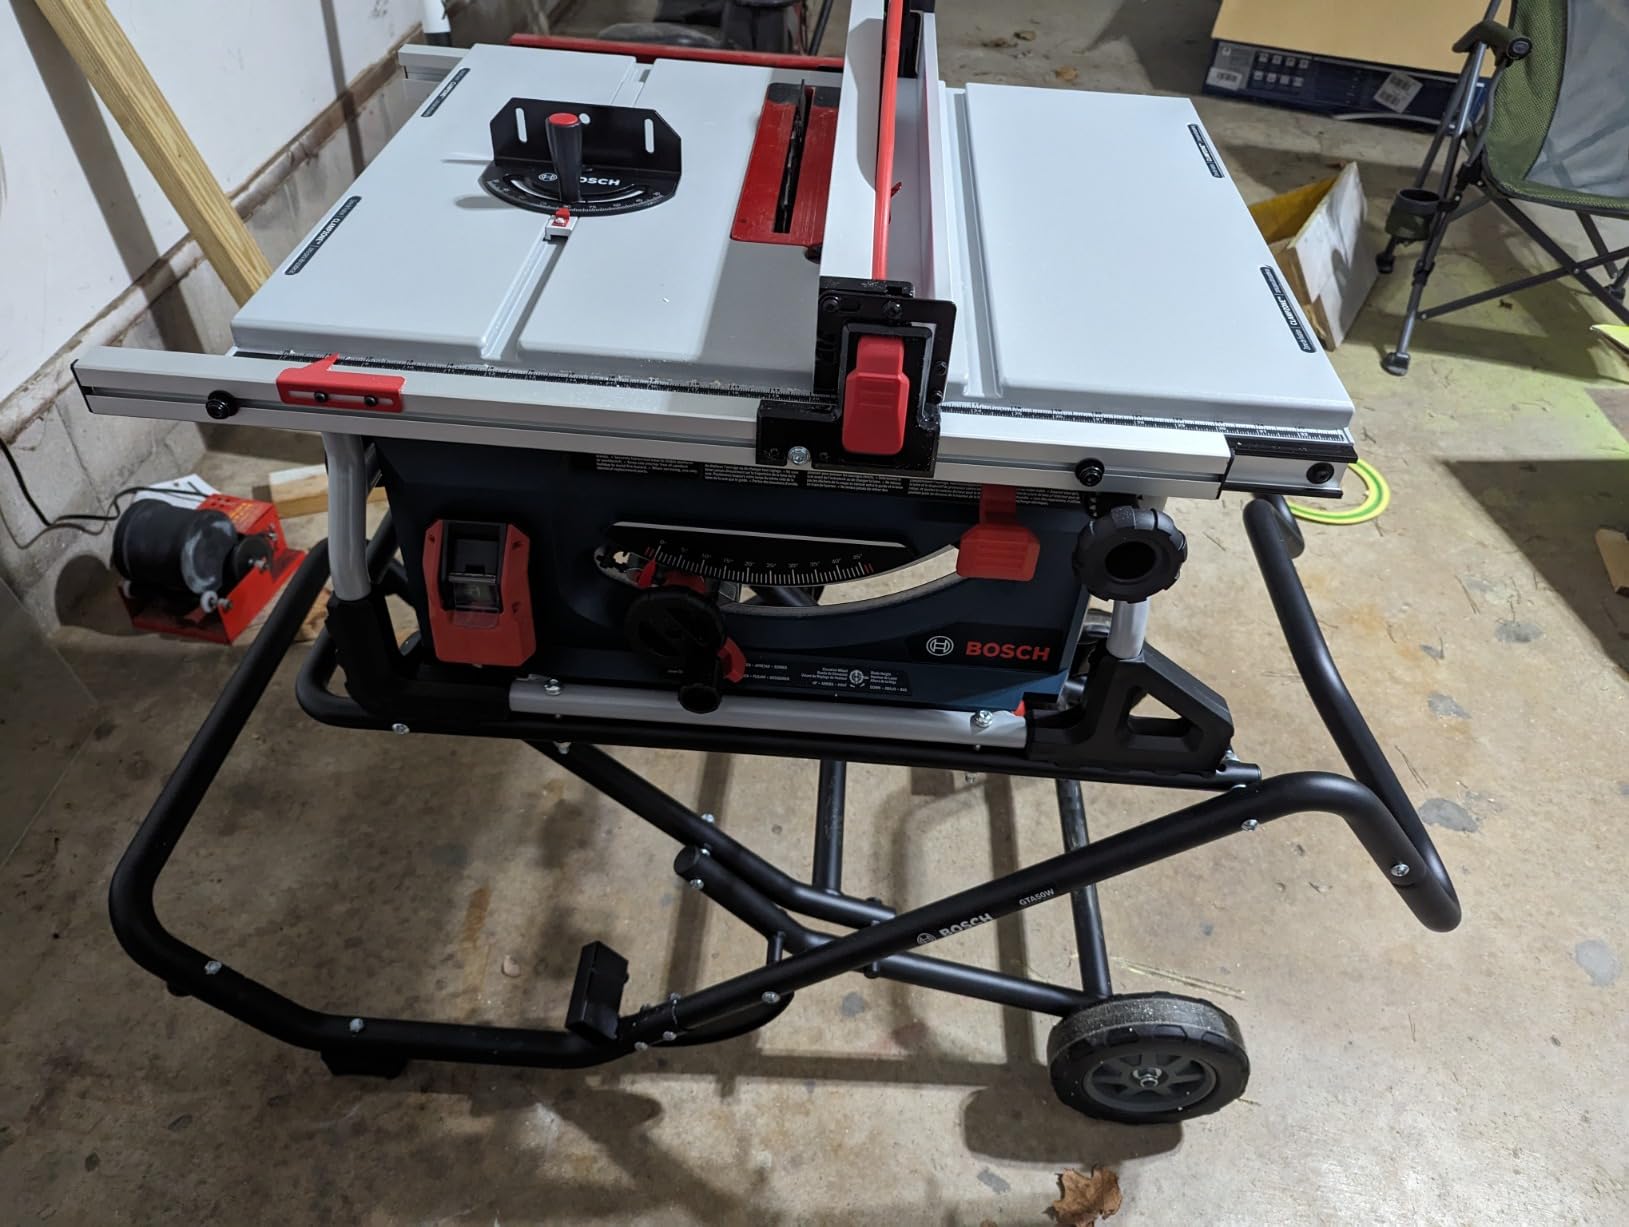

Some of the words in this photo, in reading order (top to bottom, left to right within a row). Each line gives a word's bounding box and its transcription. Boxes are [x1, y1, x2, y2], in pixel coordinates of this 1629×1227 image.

[579, 176, 621, 187] OSCH
[965, 640, 1051, 662] BOSCH
[1018, 888, 1055, 906] GTA50W
[938, 912, 993, 937] BOSCH
